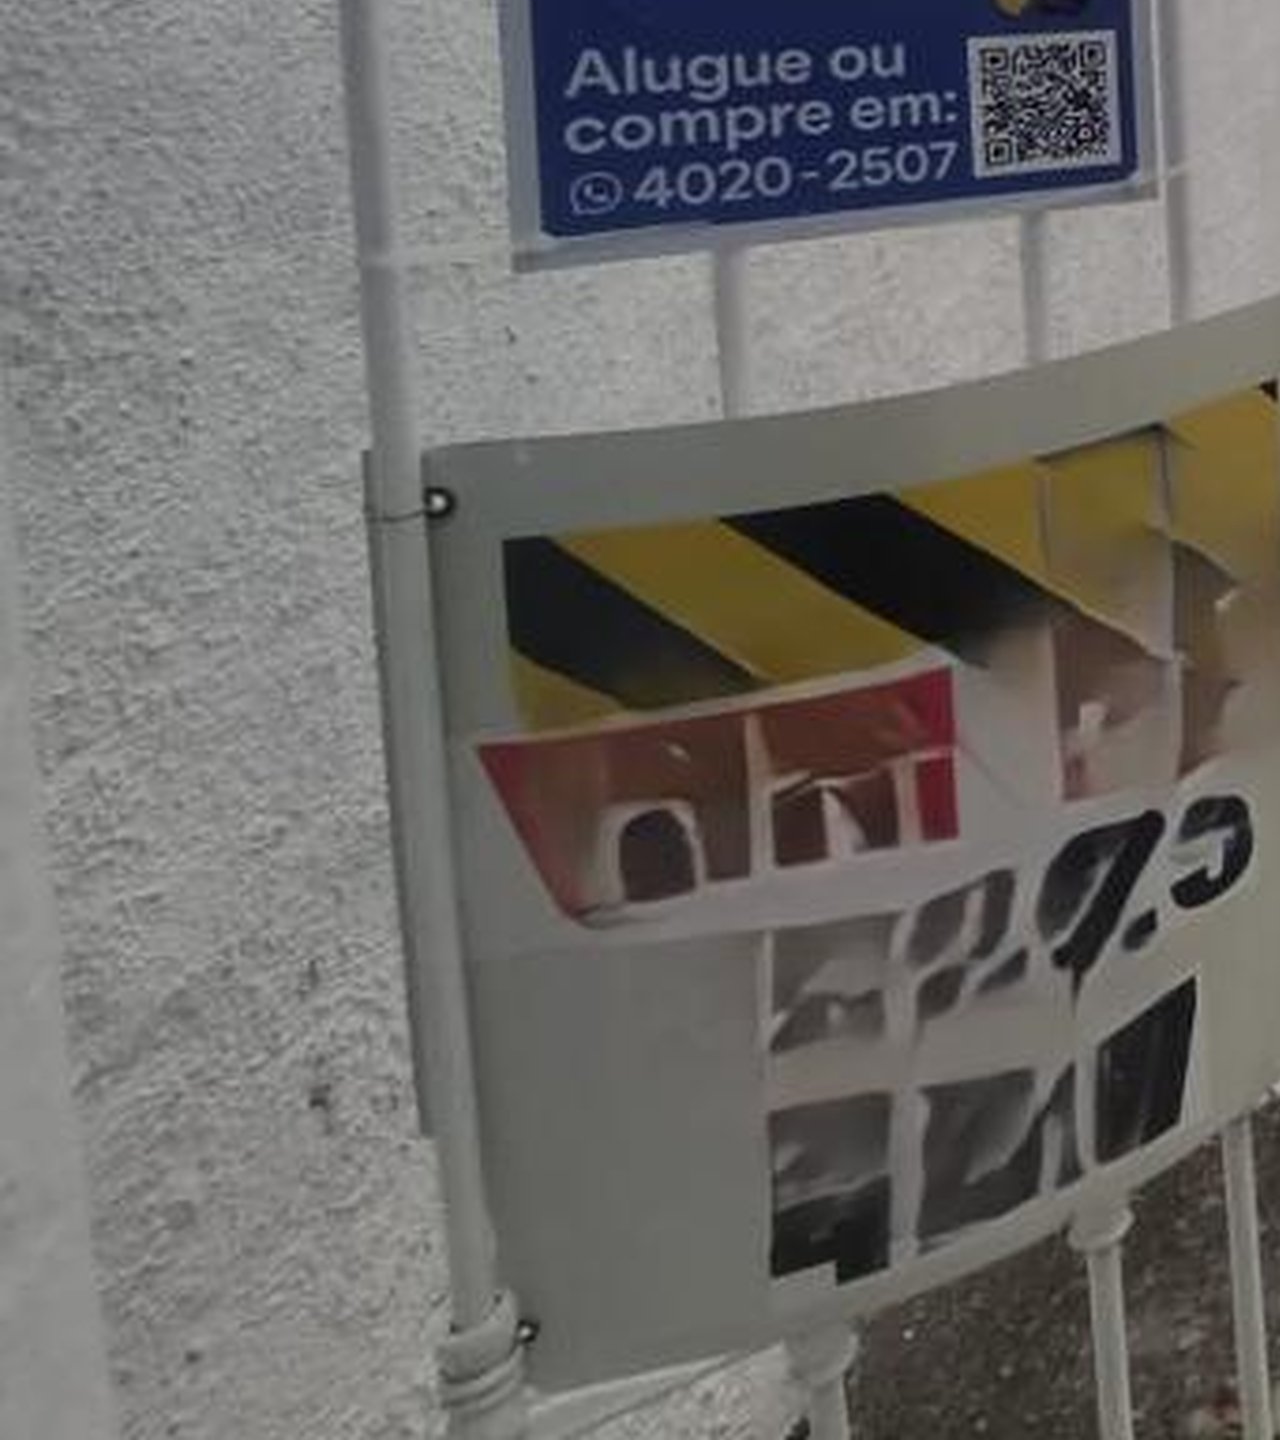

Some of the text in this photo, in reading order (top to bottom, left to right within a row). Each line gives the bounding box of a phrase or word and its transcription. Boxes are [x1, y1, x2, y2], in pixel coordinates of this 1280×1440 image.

[565, 42, 905, 102] Alugue ou
[563, 86, 957, 154] compre em:
